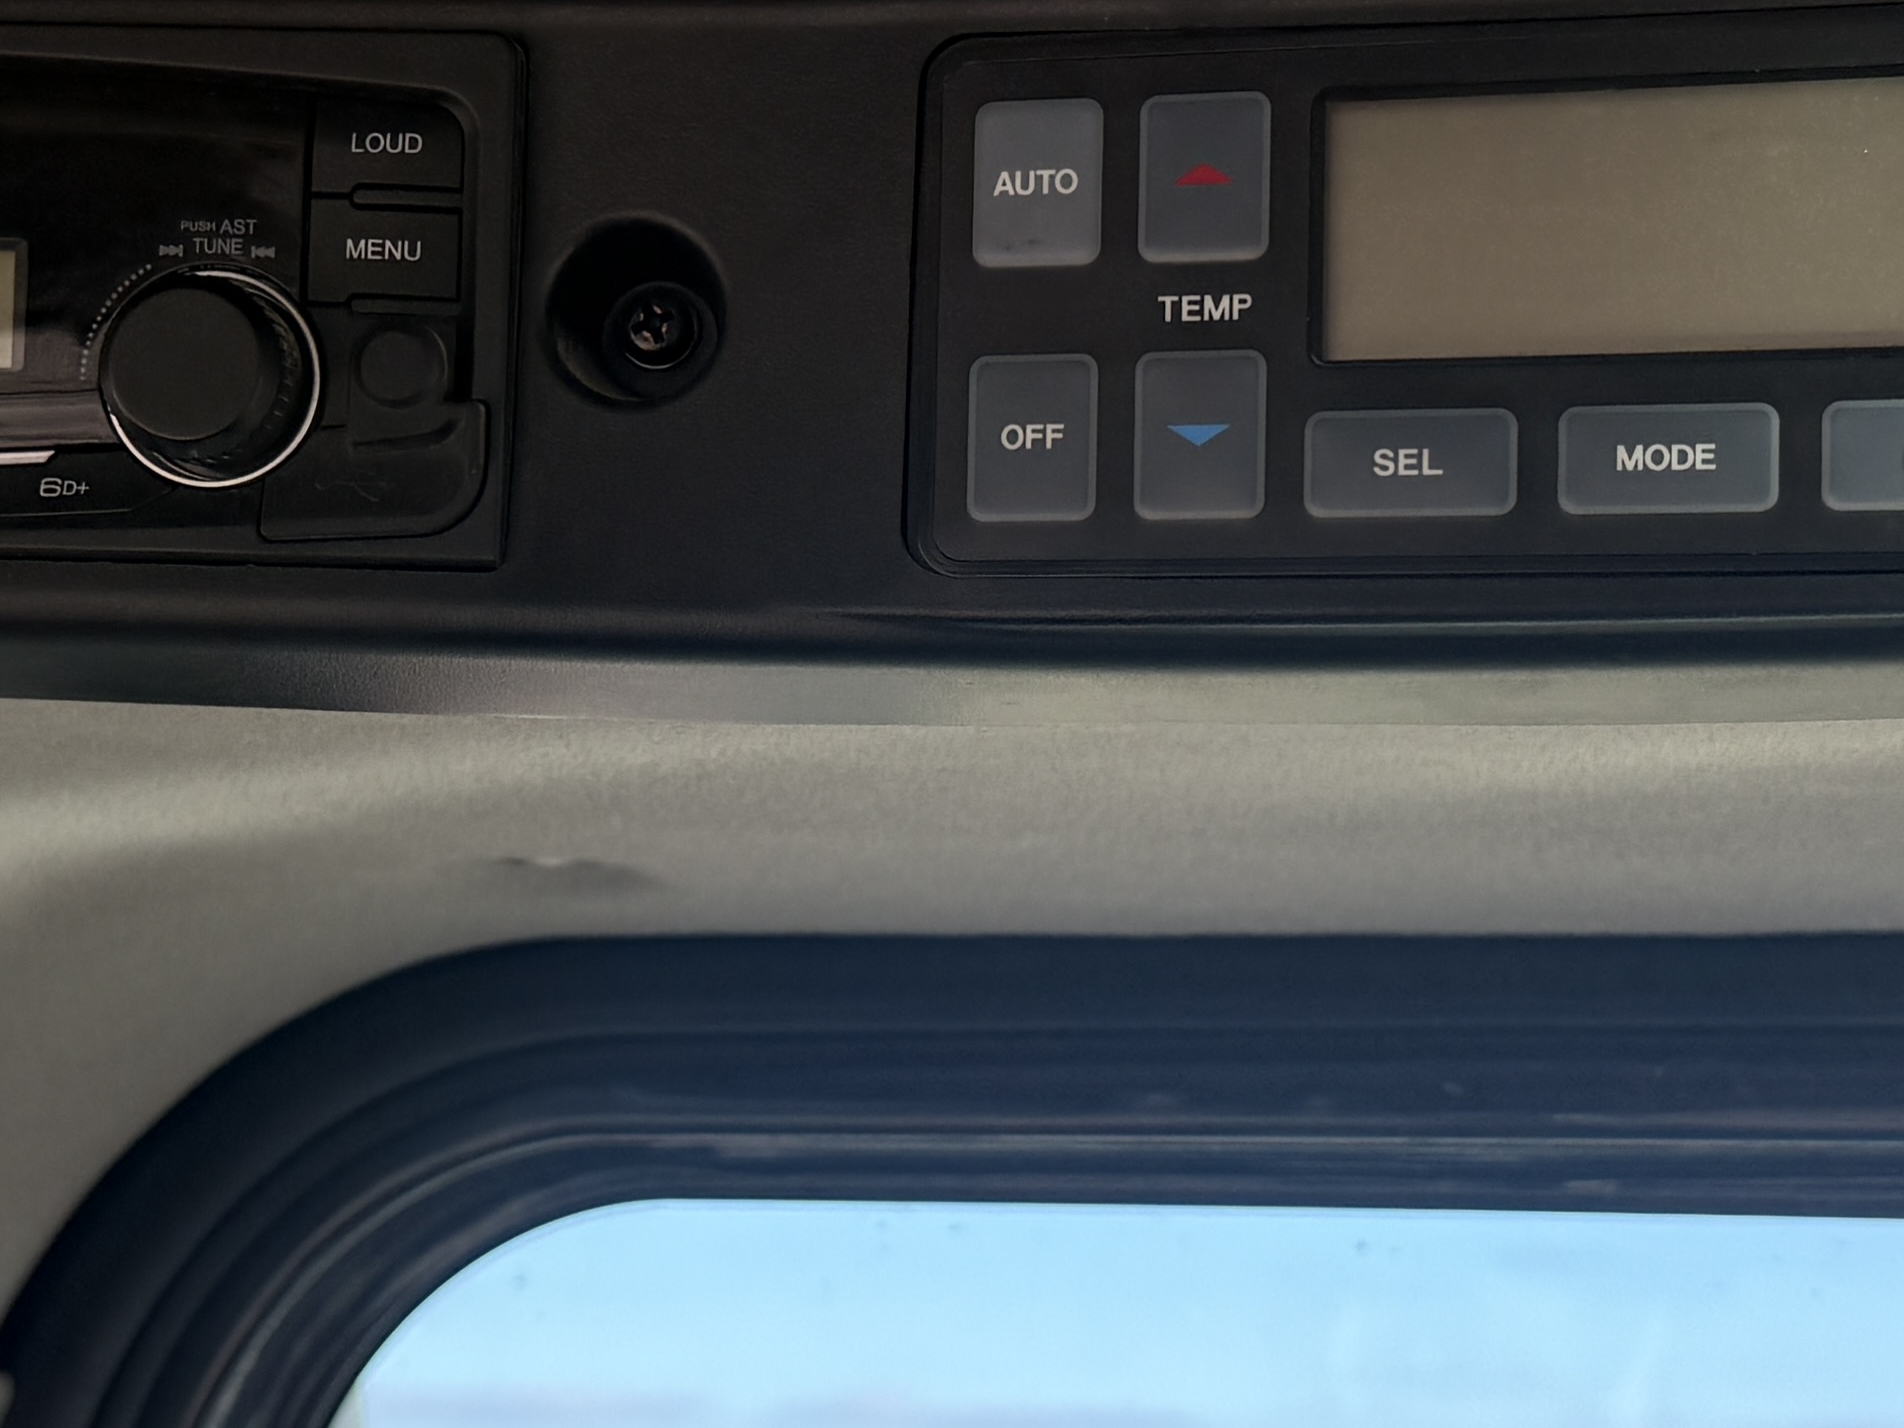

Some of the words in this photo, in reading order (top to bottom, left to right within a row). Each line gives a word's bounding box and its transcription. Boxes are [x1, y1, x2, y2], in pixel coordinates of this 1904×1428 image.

[350, 132, 423, 154] LOUD
[993, 168, 1079, 197] AUTO
[180, 220, 217, 232] PUSH
[219, 218, 258, 235] AST
[192, 237, 244, 255] TUNE
[345, 238, 422, 262] MENU
[1157, 293, 1253, 323] TEMP
[1000, 423, 1065, 451] OFF
[1373, 448, 1444, 477] SEL
[1616, 443, 1717, 472] MODE
